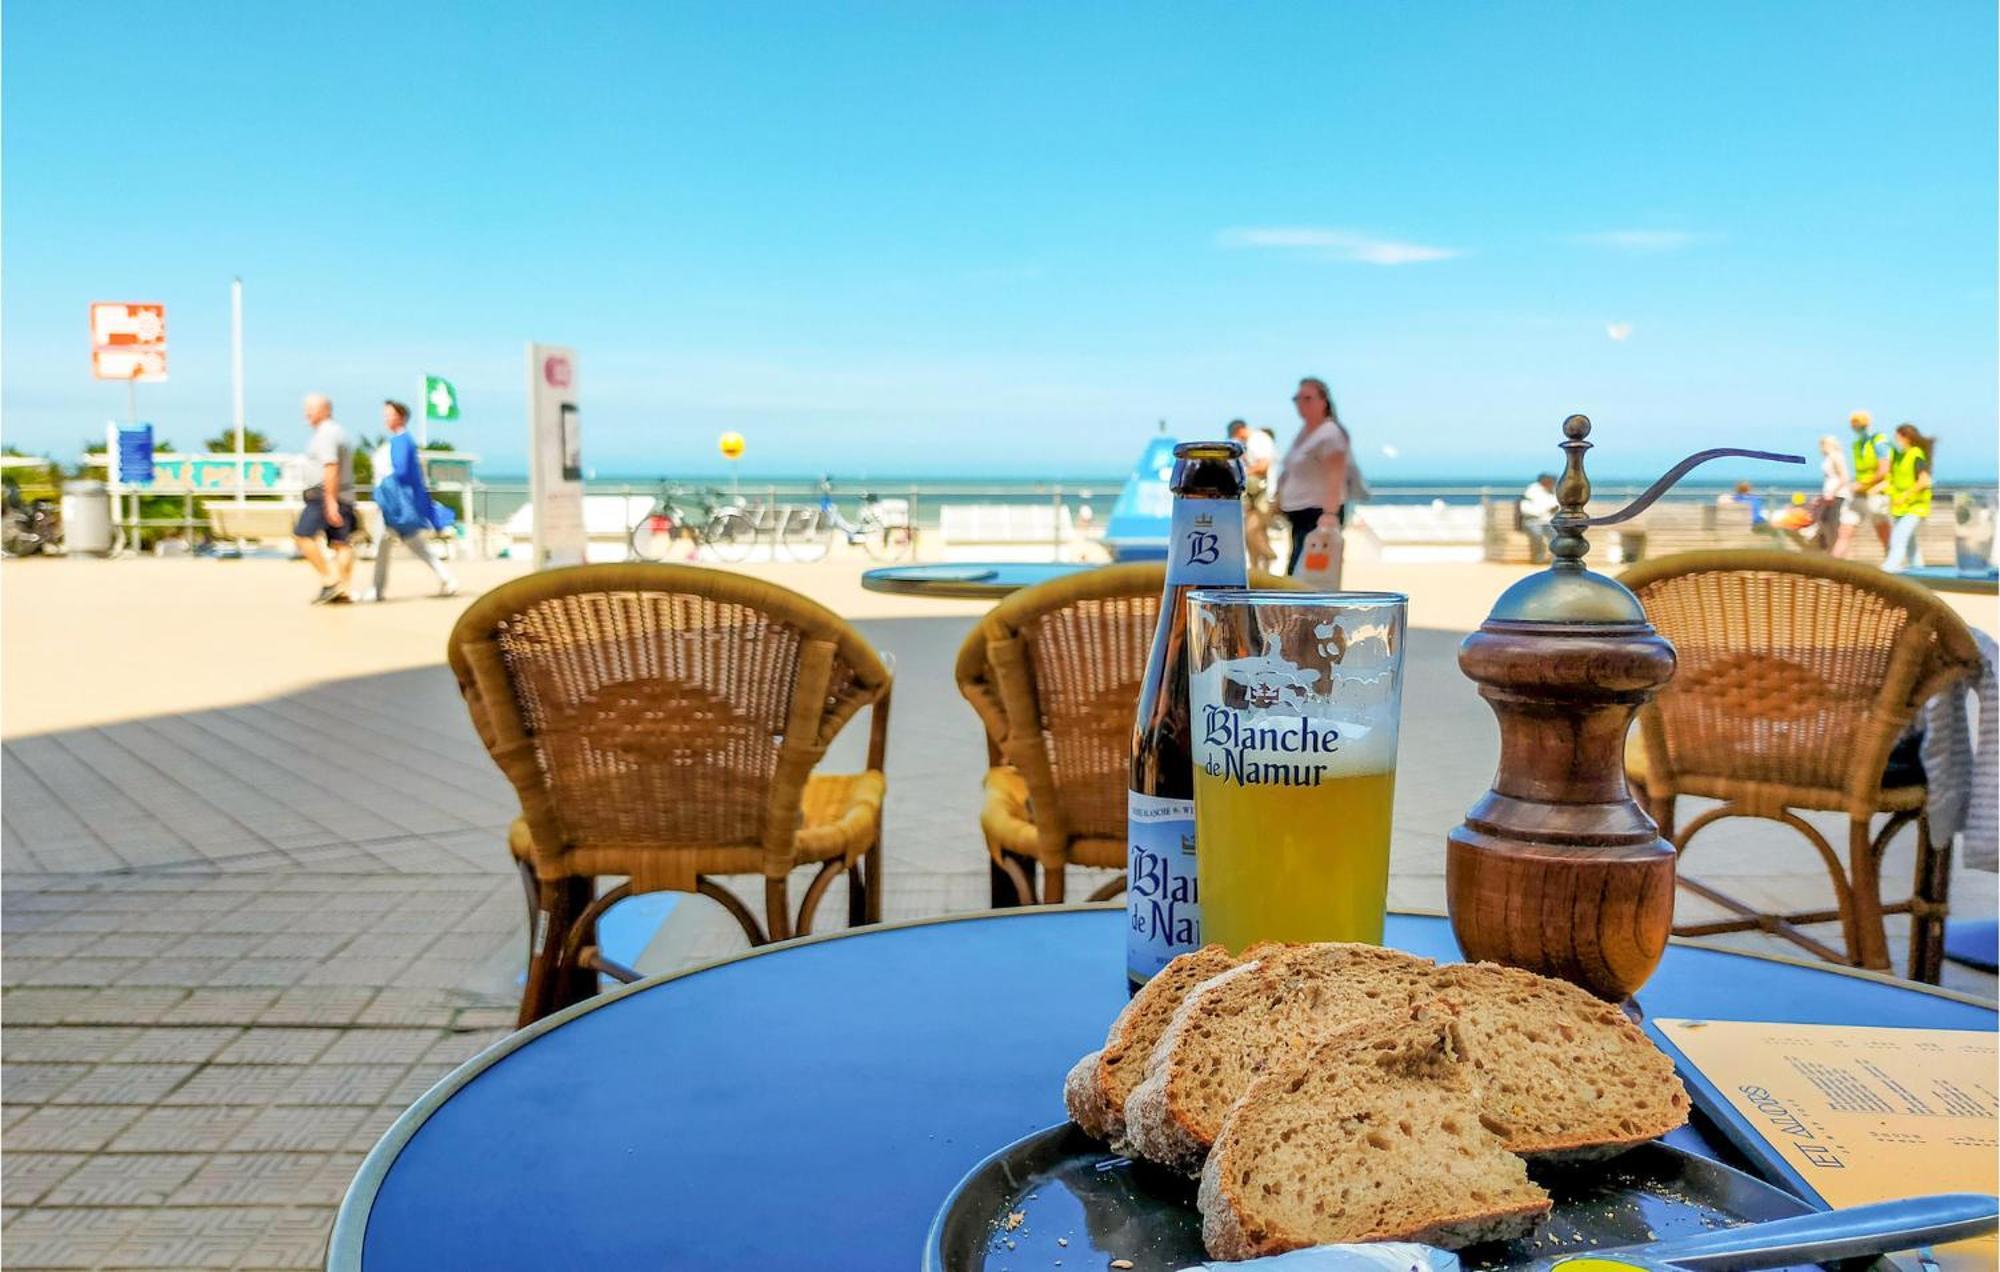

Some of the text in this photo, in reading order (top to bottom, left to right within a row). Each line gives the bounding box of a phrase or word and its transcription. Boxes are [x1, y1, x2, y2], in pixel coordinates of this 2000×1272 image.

[1187, 531, 1219, 566] B
[1203, 704, 1339, 752] Blanche
[1206, 747, 1328, 787] de Namur
[1132, 903, 1146, 933] de
